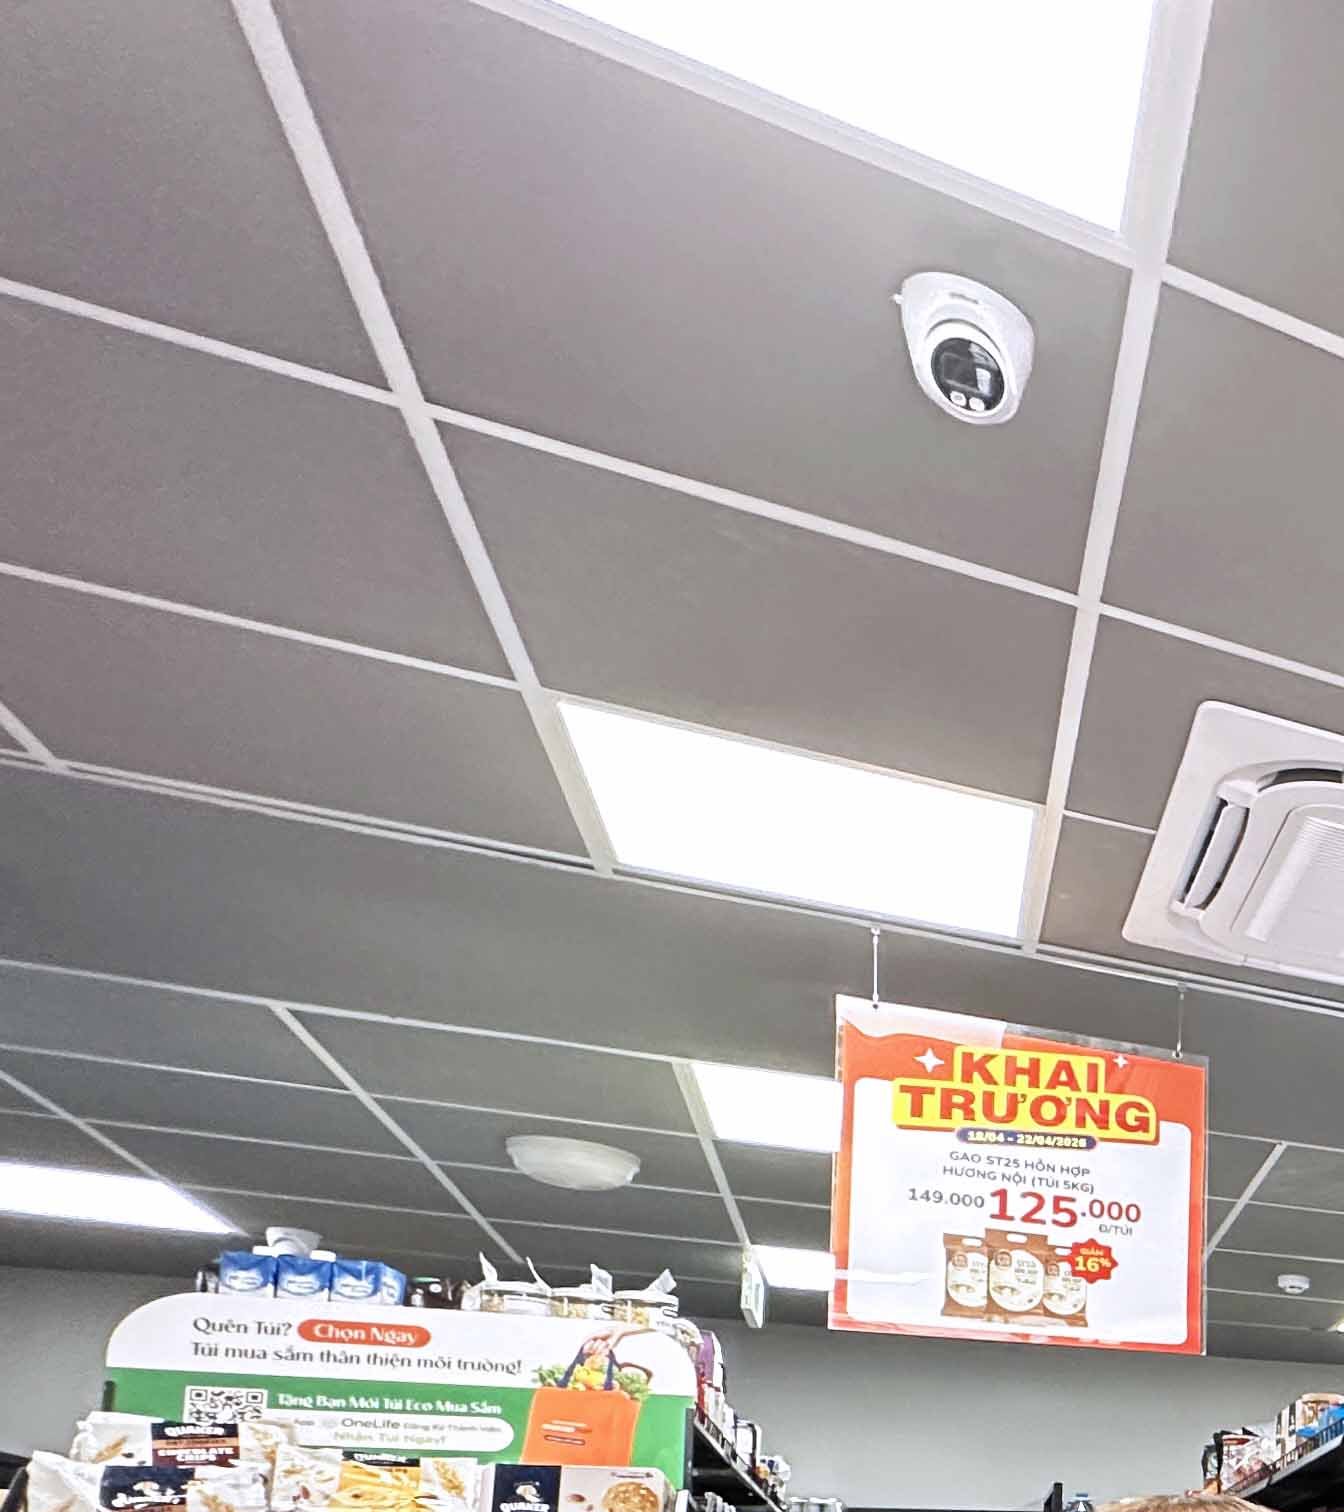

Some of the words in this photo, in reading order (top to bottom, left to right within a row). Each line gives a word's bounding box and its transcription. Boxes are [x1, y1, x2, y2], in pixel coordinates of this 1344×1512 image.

[961, 1052, 1098, 1092] KHAI
[899, 1084, 1151, 1134] TRƯƠNG
[986, 1155, 1021, 1169] ST25
[943, 1165, 997, 1181] HƯƠNG
[1063, 1180, 1095, 1194] 5KG)
[907, 1187, 985, 1209] 149.000
[990, 1188, 1141, 1228] 125.000
[1075, 1256, 1112, 1273] 16%
[193, 1316, 249, 1338] Quên
[256, 1320, 292, 1337] Túi?
[313, 1321, 367, 1344] Chọn
[370, 1325, 418, 1346] Ngay
[191, 1341, 219, 1358] Túi
[224, 1347, 268, 1361] mua
[273, 1344, 314, 1363] sắm
[319, 1347, 361, 1365] thân
[366, 1351, 413, 1370] thiện
[417, 1355, 452, 1370] môi
[457, 1356, 523, 1377] trường!
[406, 1398, 434, 1413] Eco
[436, 1399, 470, 1414] Mua
[341, 1416, 401, 1431] OneLife
